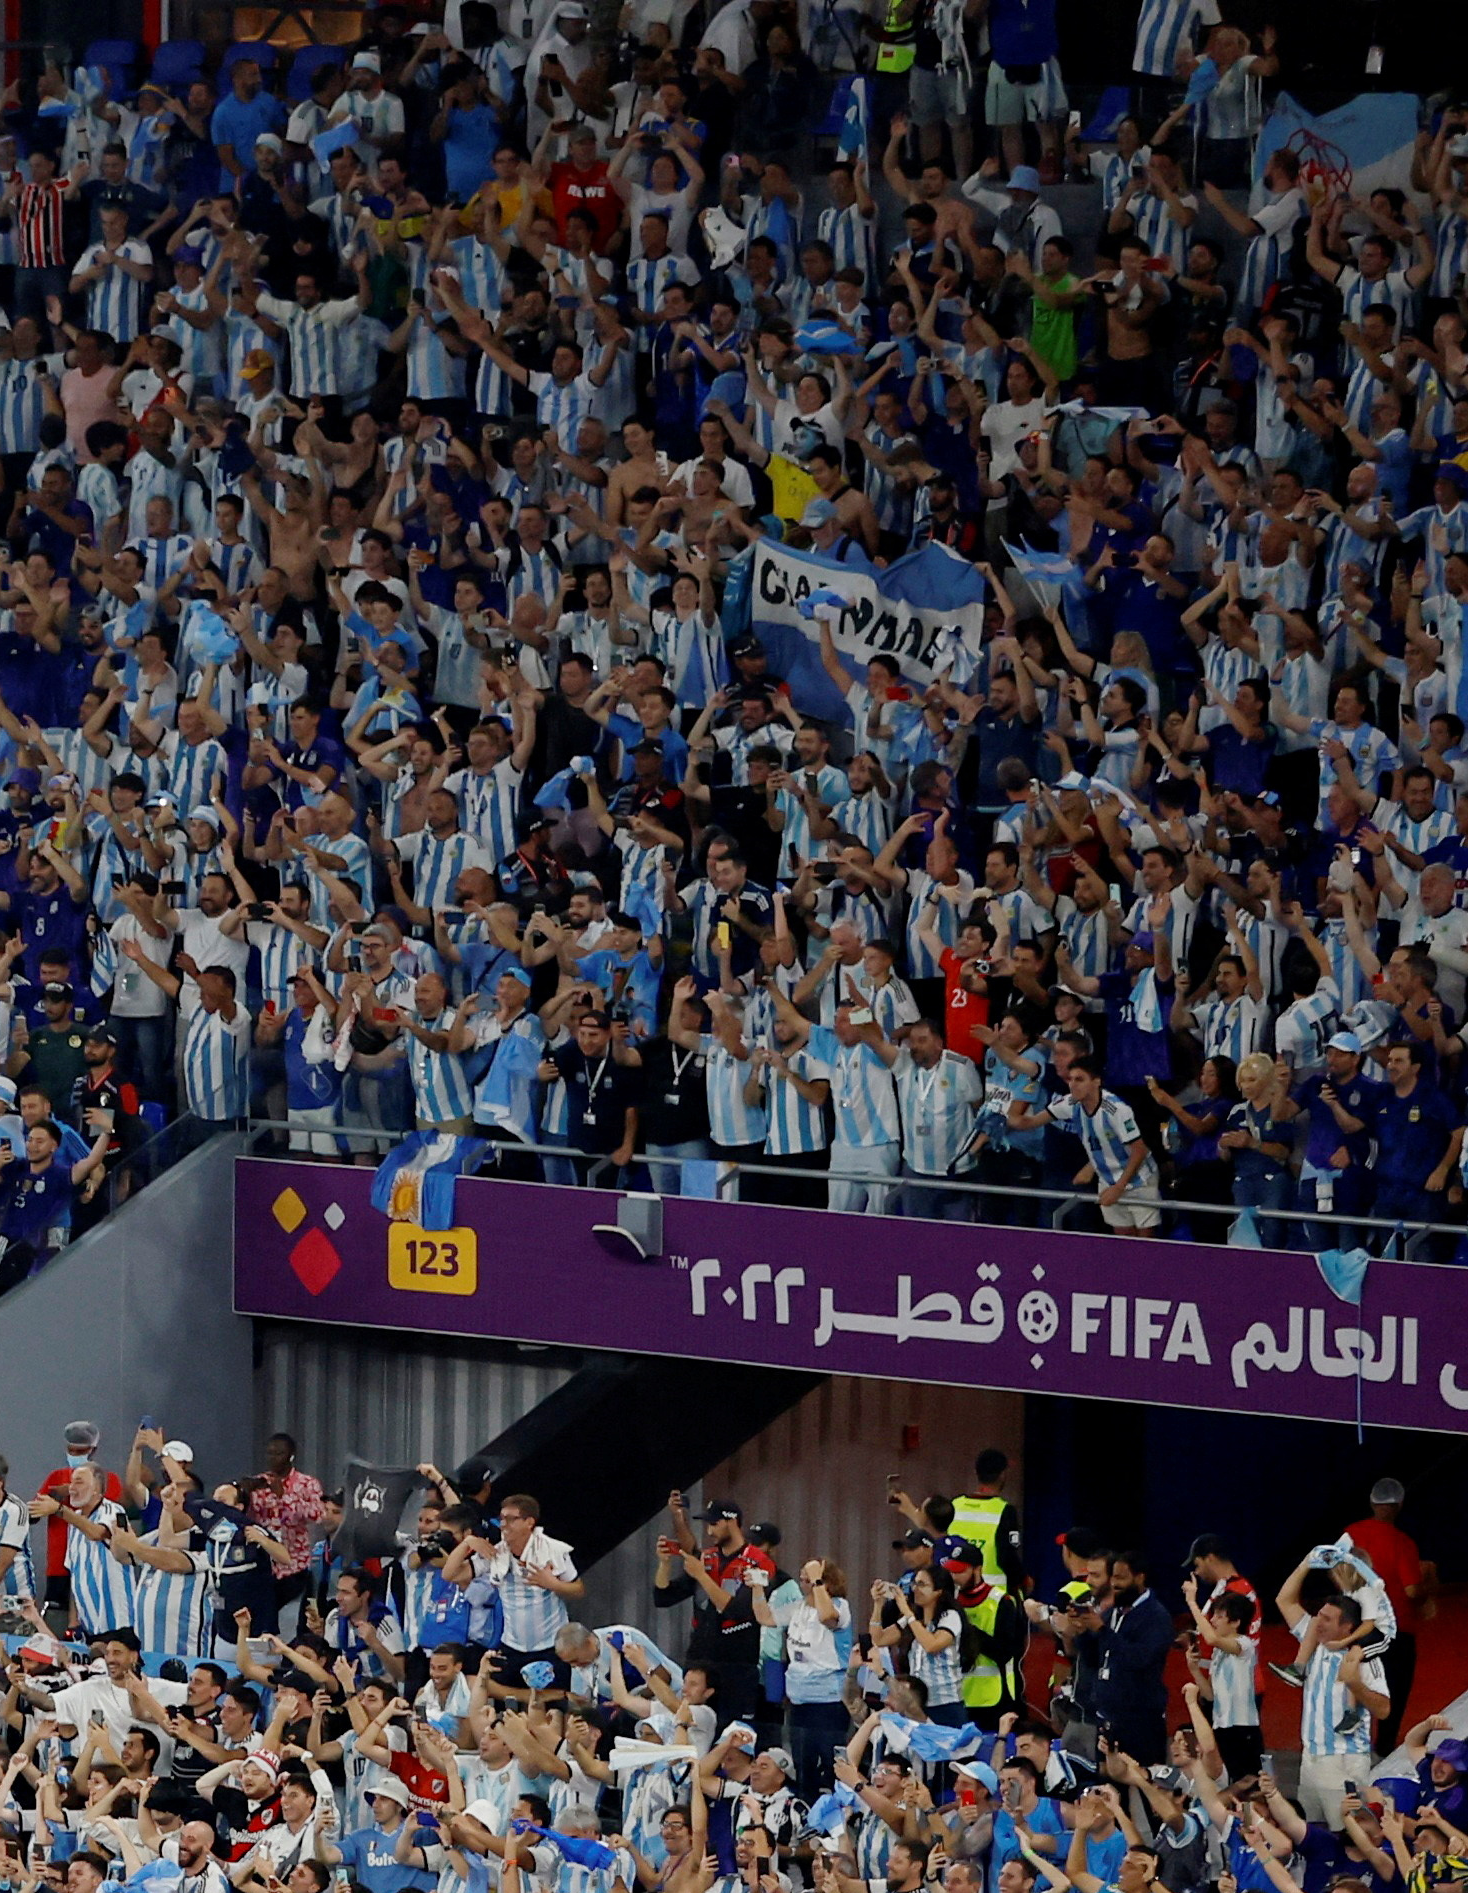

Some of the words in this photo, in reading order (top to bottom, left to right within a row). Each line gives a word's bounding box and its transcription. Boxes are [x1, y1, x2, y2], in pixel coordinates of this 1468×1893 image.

[406, 1240, 459, 1278] 123
[814, 1260, 1005, 1348] قطر
[1071, 1292, 1211, 1366] FIFA
[1230, 1305, 1419, 1388] العالم
